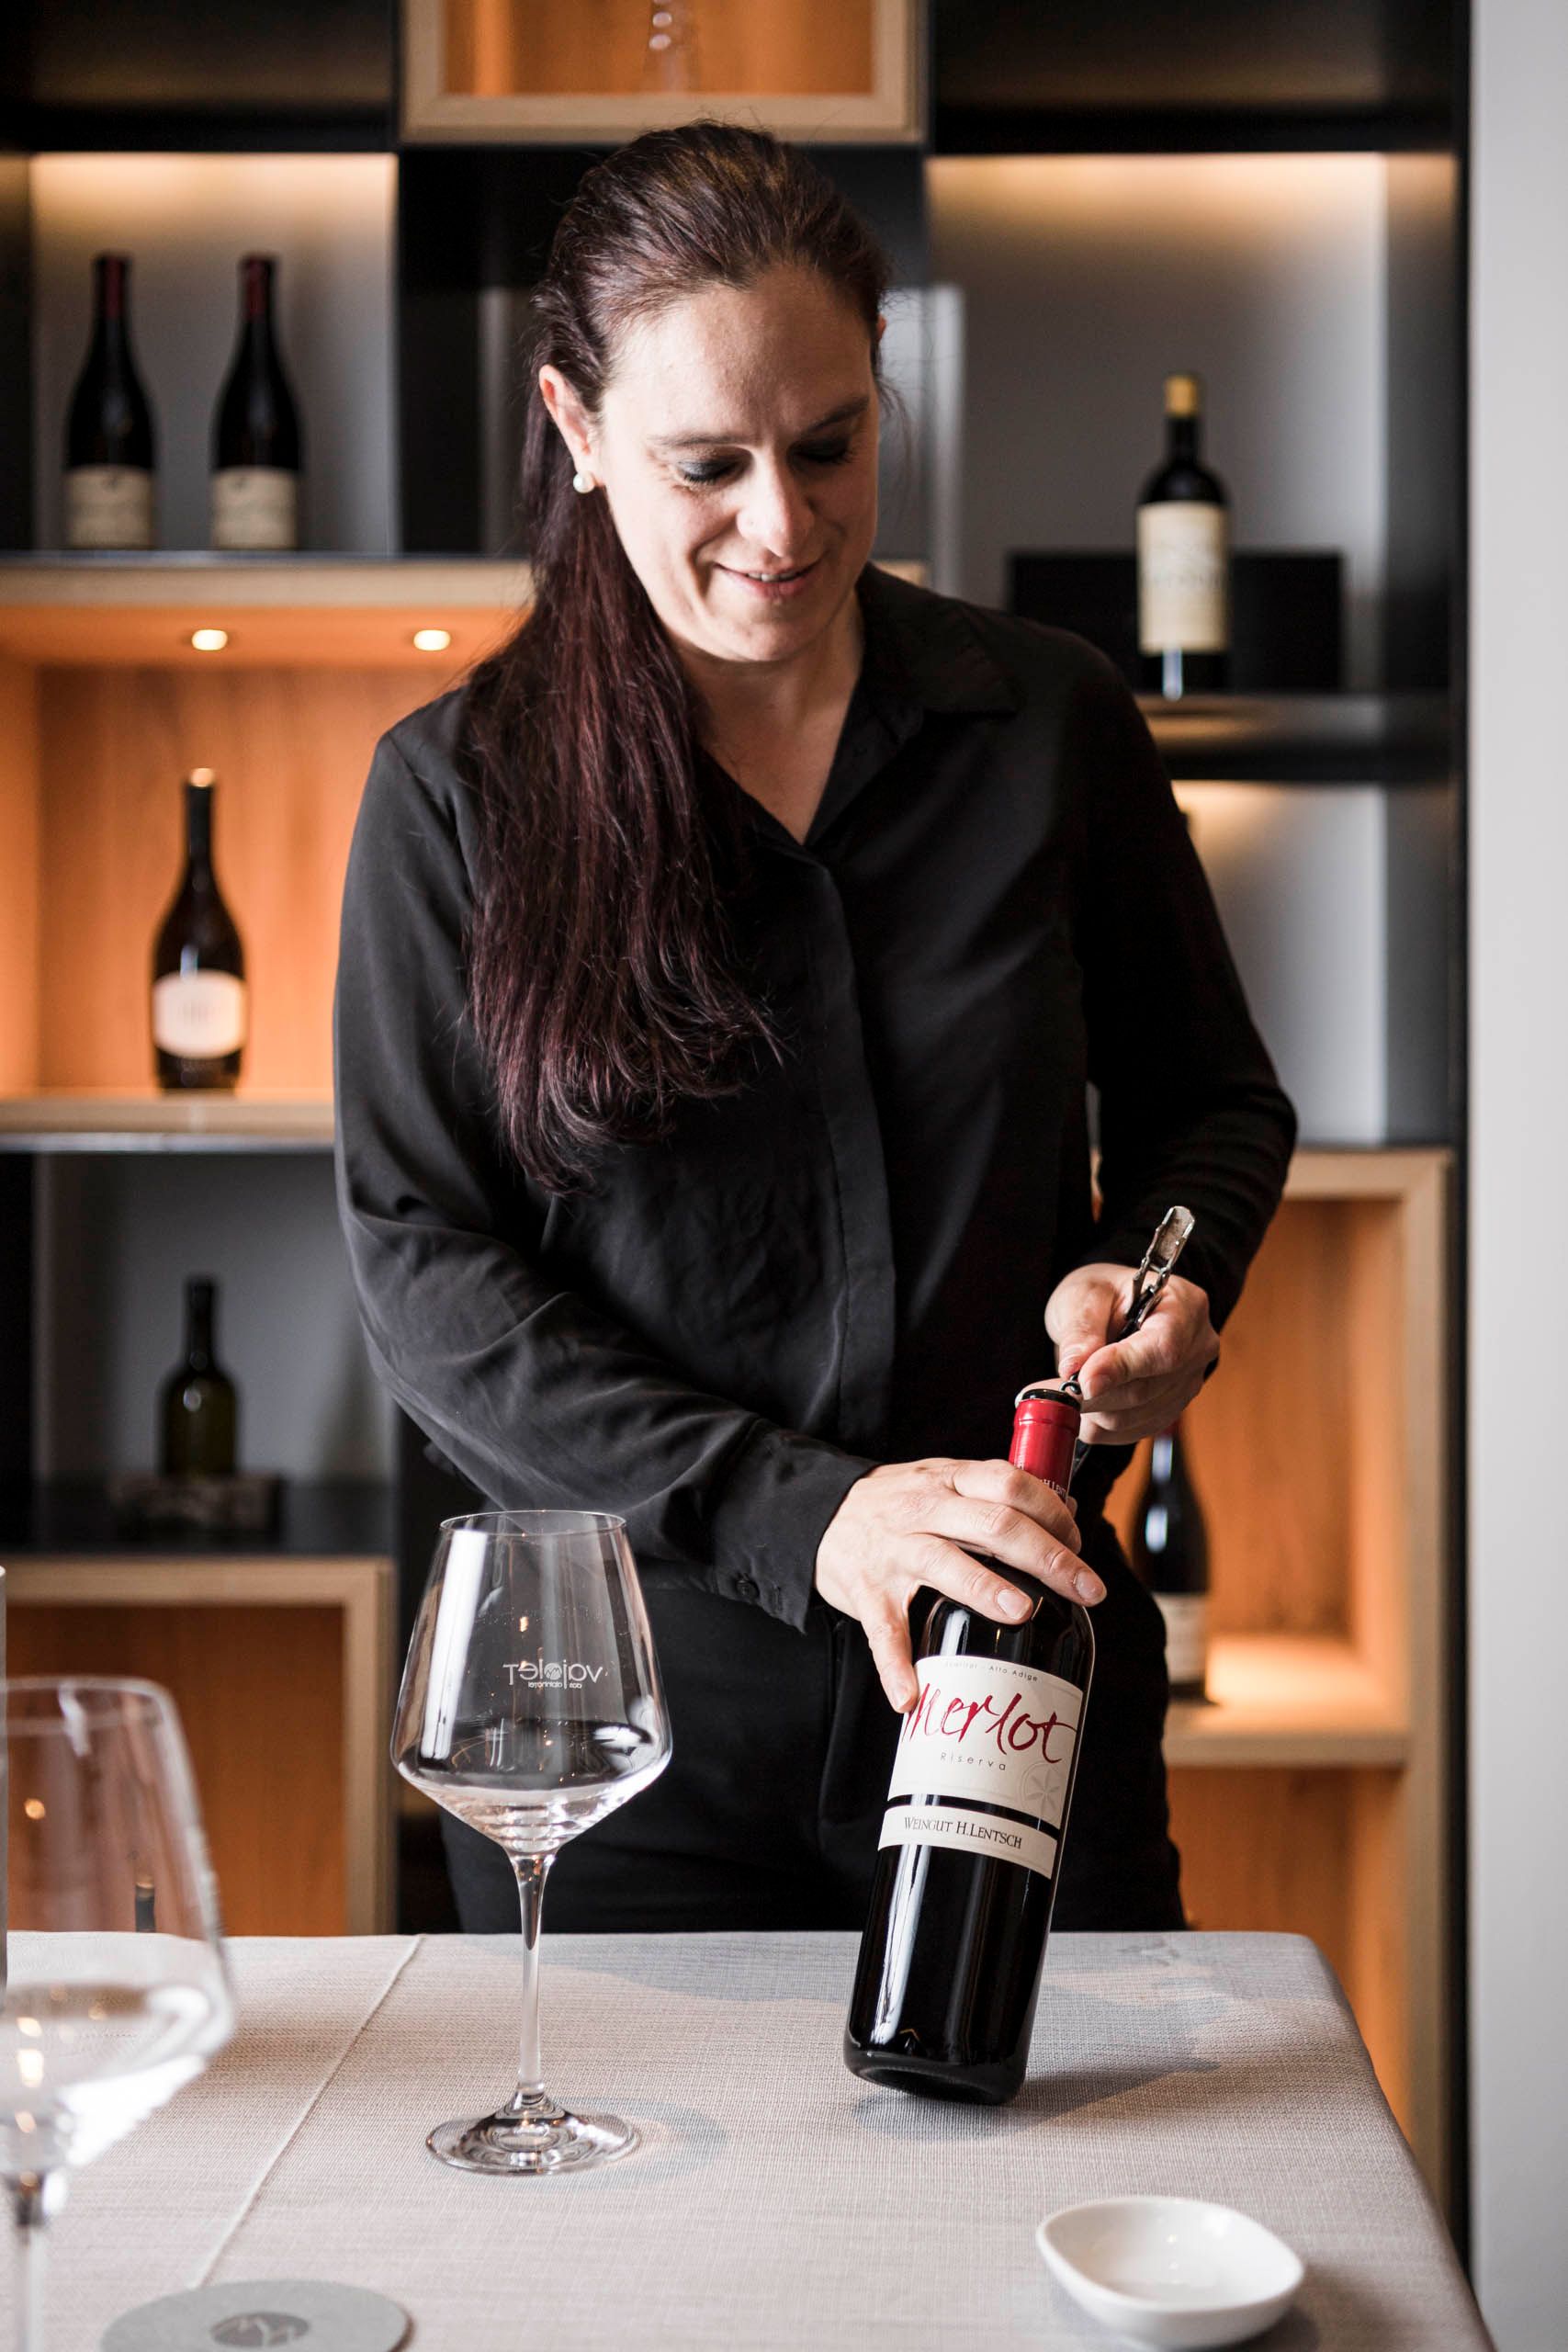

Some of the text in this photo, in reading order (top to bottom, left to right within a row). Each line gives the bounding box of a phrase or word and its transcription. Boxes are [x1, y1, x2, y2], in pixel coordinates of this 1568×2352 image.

[1012, 1669, 1038, 1682] Adige
[902, 1683, 1077, 1763] Merlot
[940, 1751, 1006, 1770] Riserva
[905, 1816, 953, 1833] WEINGUT
